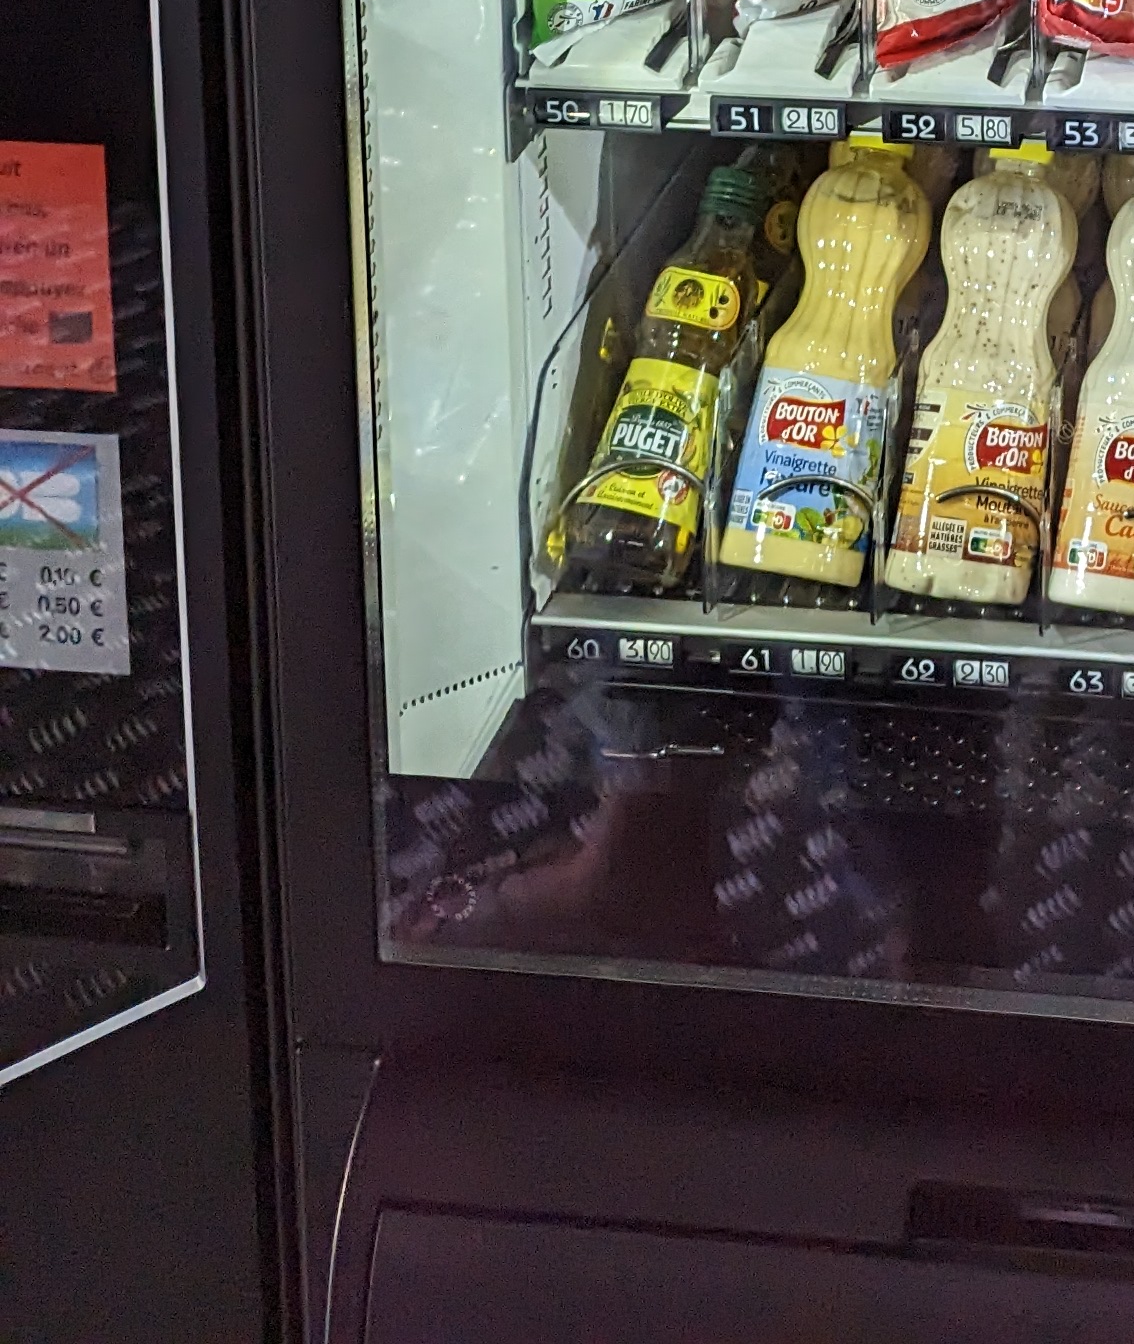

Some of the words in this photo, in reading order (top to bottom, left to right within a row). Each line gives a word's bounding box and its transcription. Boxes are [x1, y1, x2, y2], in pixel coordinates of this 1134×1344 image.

[546, 100, 578, 122] 50
[730, 107, 760, 130] 51
[901, 115, 936, 139] 52
[1065, 122, 1099, 146] 53
[775, 402, 839, 424] BOUTON
[612, 422, 681, 457] PUGET
[781, 423, 817, 443] d'OR
[986, 426, 1044, 448] BOUTON
[765, 449, 837, 477] Vinaigrette
[567, 638, 599, 660] 60
[741, 648, 771, 671] 61
[901, 658, 936, 682] 62
[1069, 670, 1104, 693] 63
